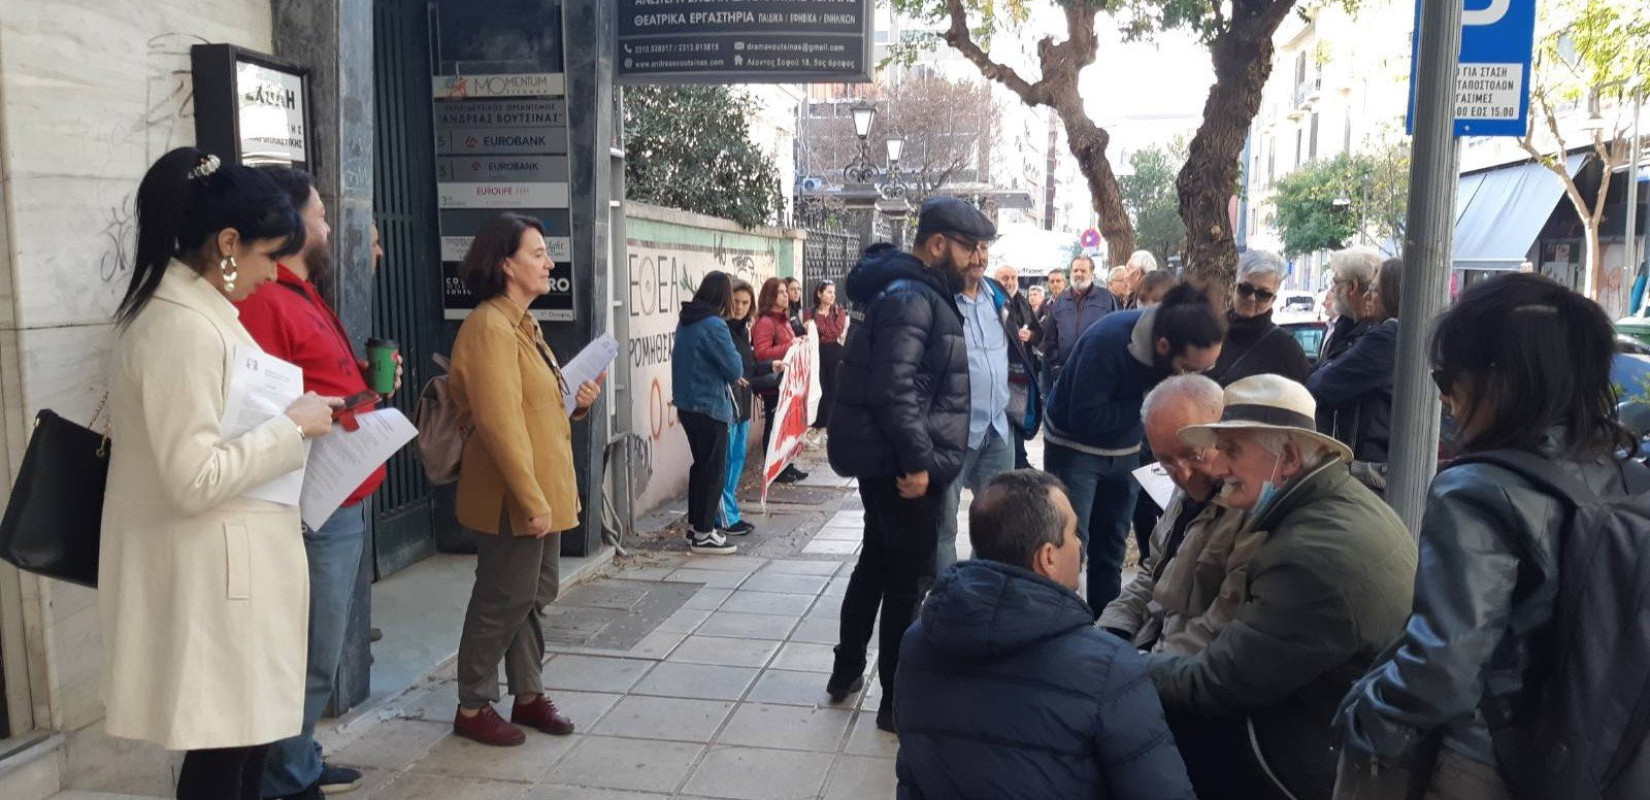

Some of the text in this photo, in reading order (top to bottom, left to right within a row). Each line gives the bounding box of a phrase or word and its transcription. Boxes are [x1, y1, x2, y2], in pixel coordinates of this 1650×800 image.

[634, 13, 686, 27] ΘΕΑΤΡΙΚΑ
[690, 11, 755, 24] ΕΡΓΑΣΤΗΡΙΑ
[1463, 67, 1508, 77] ΓΙΑ ΣΤΑΣΗ
[474, 77, 547, 96] MOMENTUM
[1471, 106, 1488, 117] ΕΩΣ
[483, 136, 546, 147] EUROBANK
[488, 162, 539, 171] EUROBANK
[476, 187, 513, 195] EUROLIFE
